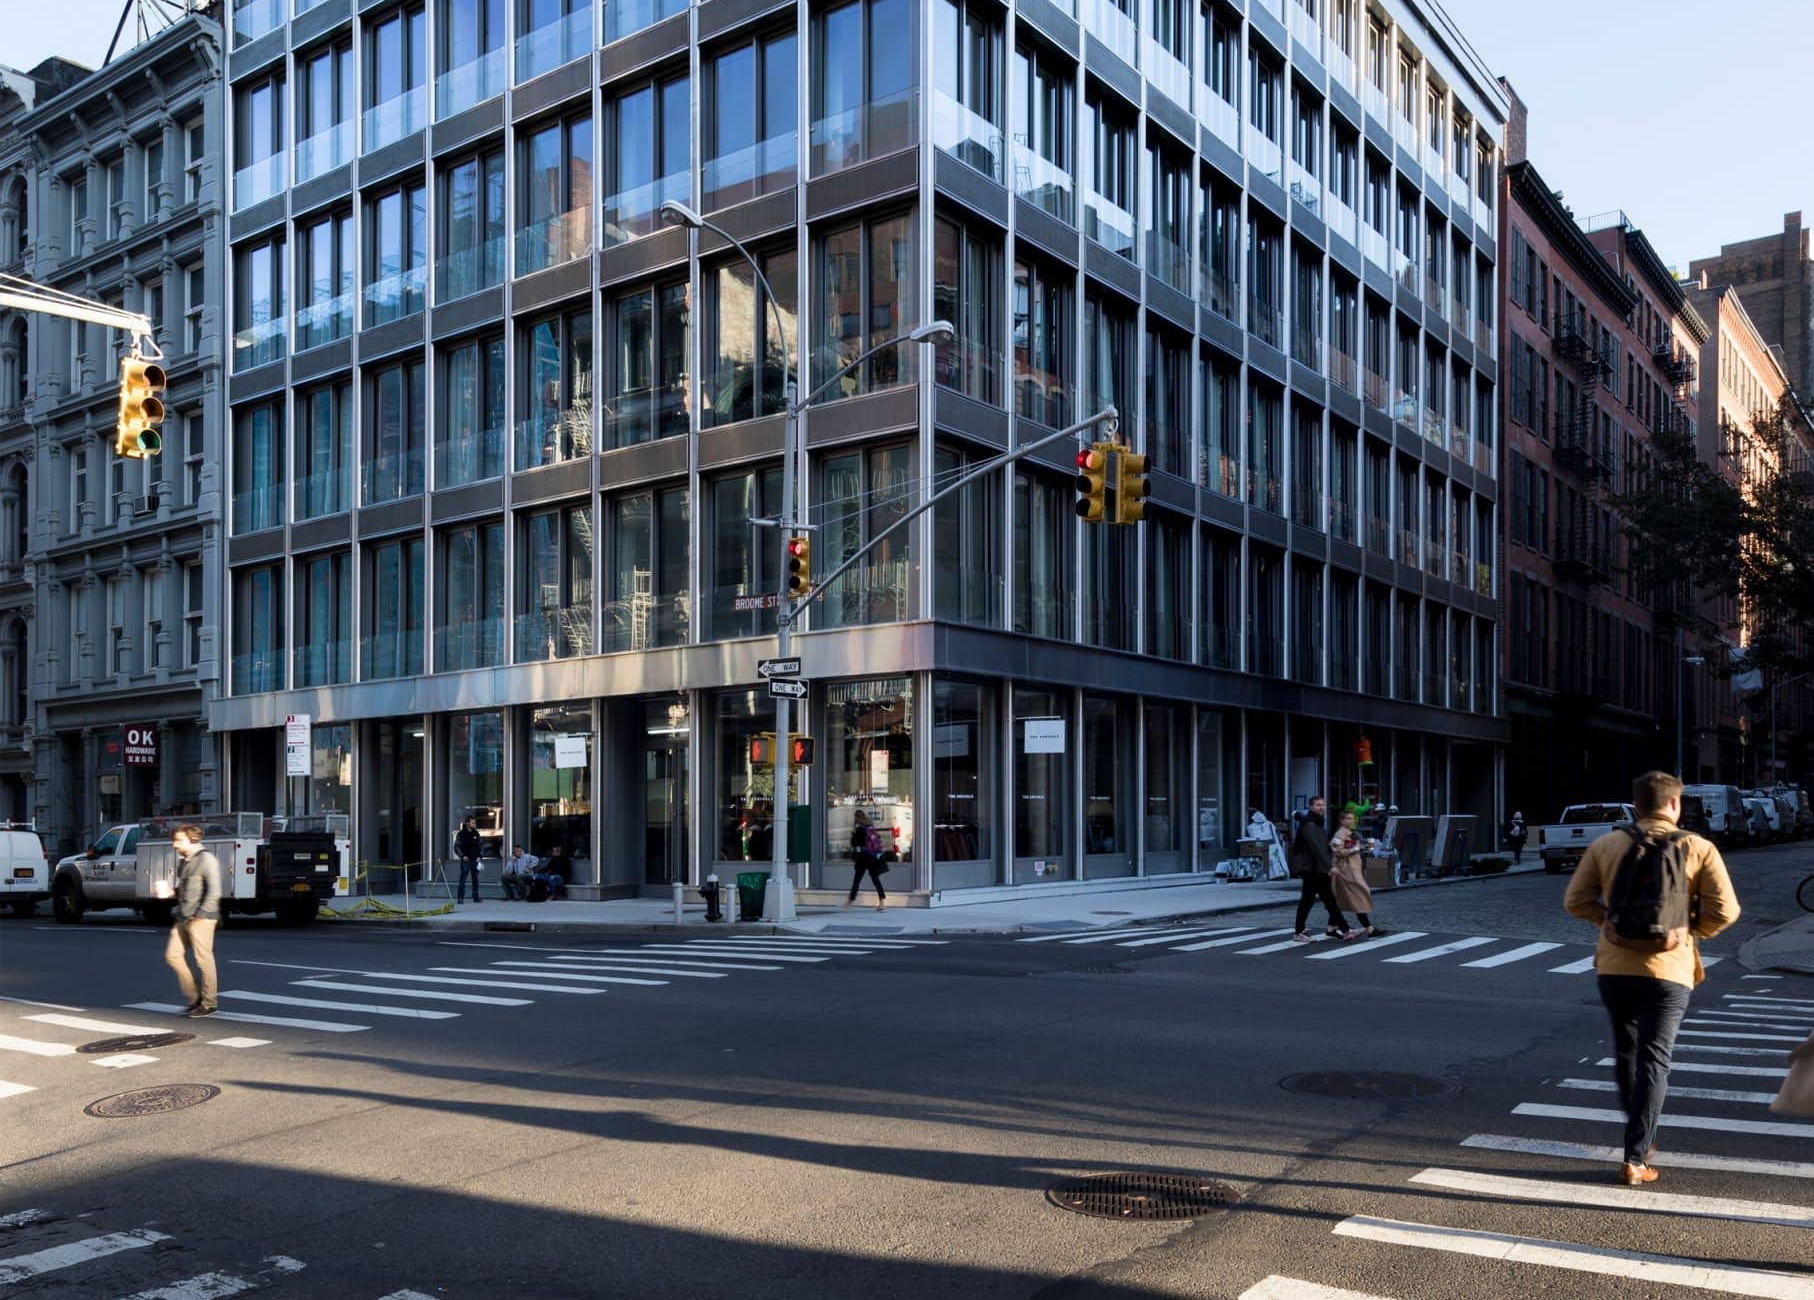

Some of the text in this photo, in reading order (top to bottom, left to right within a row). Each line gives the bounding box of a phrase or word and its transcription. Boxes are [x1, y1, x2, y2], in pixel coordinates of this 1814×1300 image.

[735, 595, 776, 611] BROOME ST
[763, 662, 797, 673] ONE WAY
[774, 683, 787, 692] ONE
[128, 730, 153, 745] OK
[125, 747, 156, 755] HARDWARE
